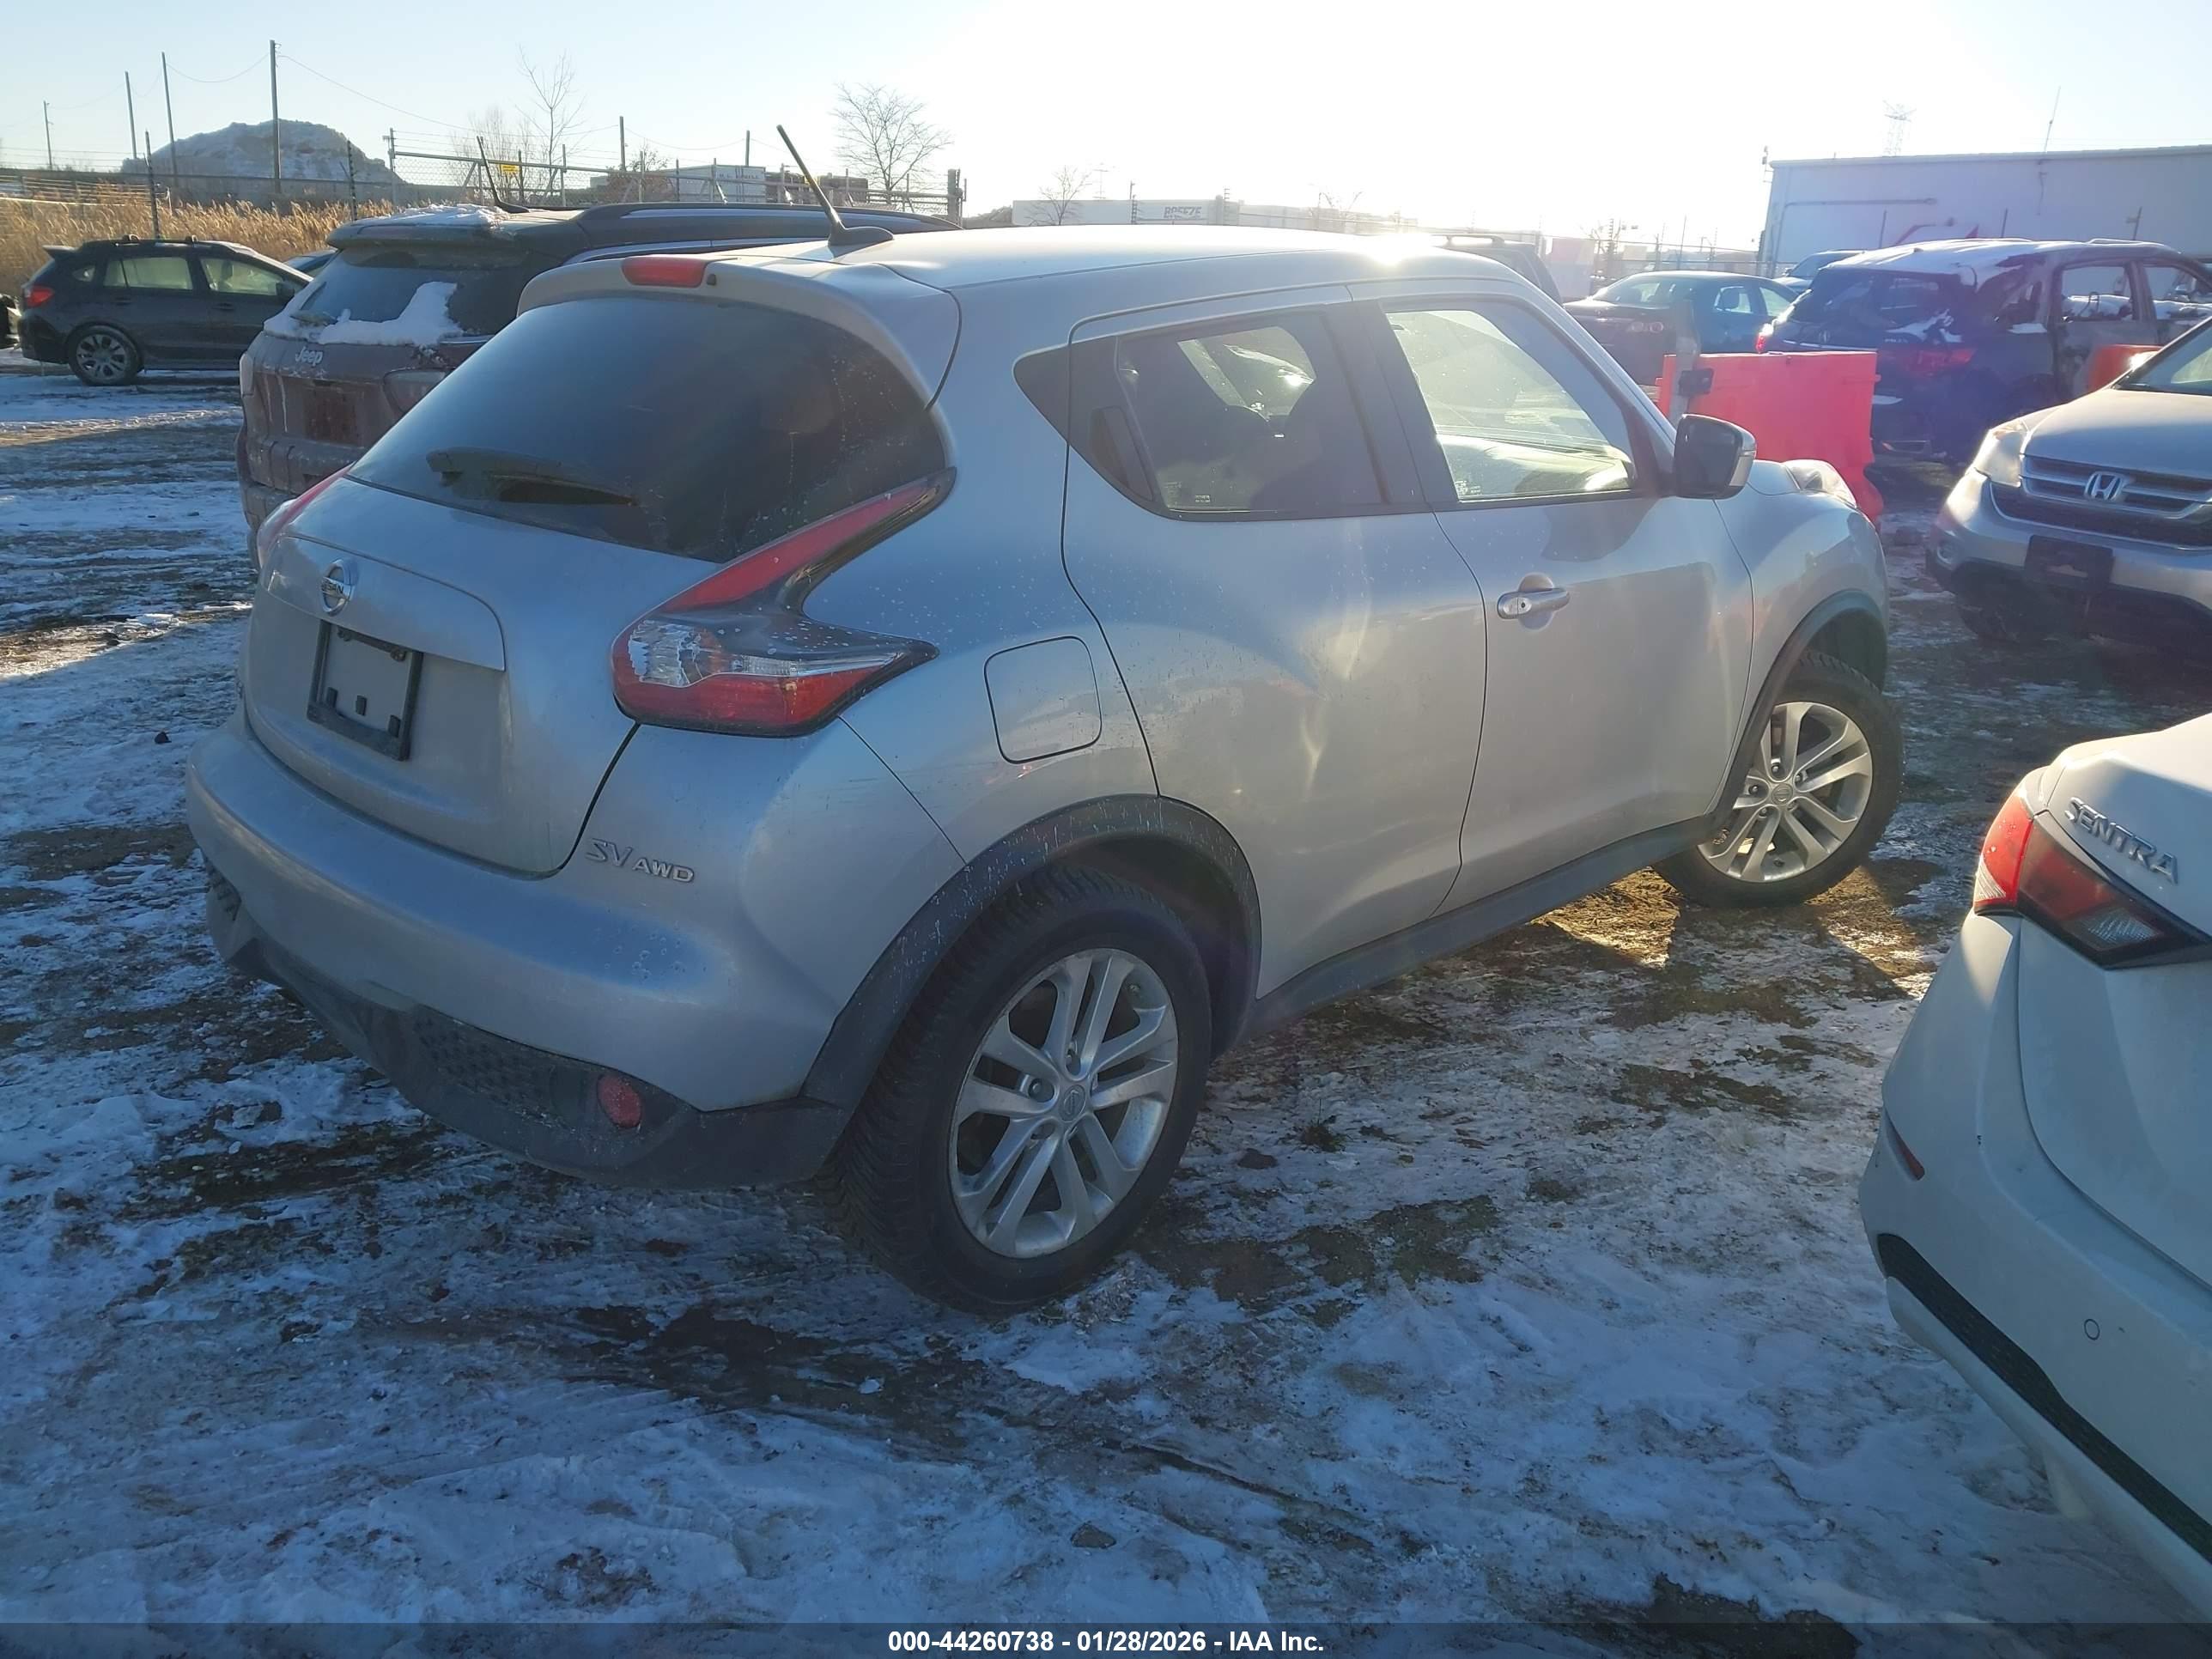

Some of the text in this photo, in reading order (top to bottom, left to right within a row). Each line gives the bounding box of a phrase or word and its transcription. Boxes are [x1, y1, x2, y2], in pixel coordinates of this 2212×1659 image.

[295, 346, 324, 367] Jeep
[585, 837, 695, 883] SV AWD
[2064, 796, 2179, 885] SENTRA
